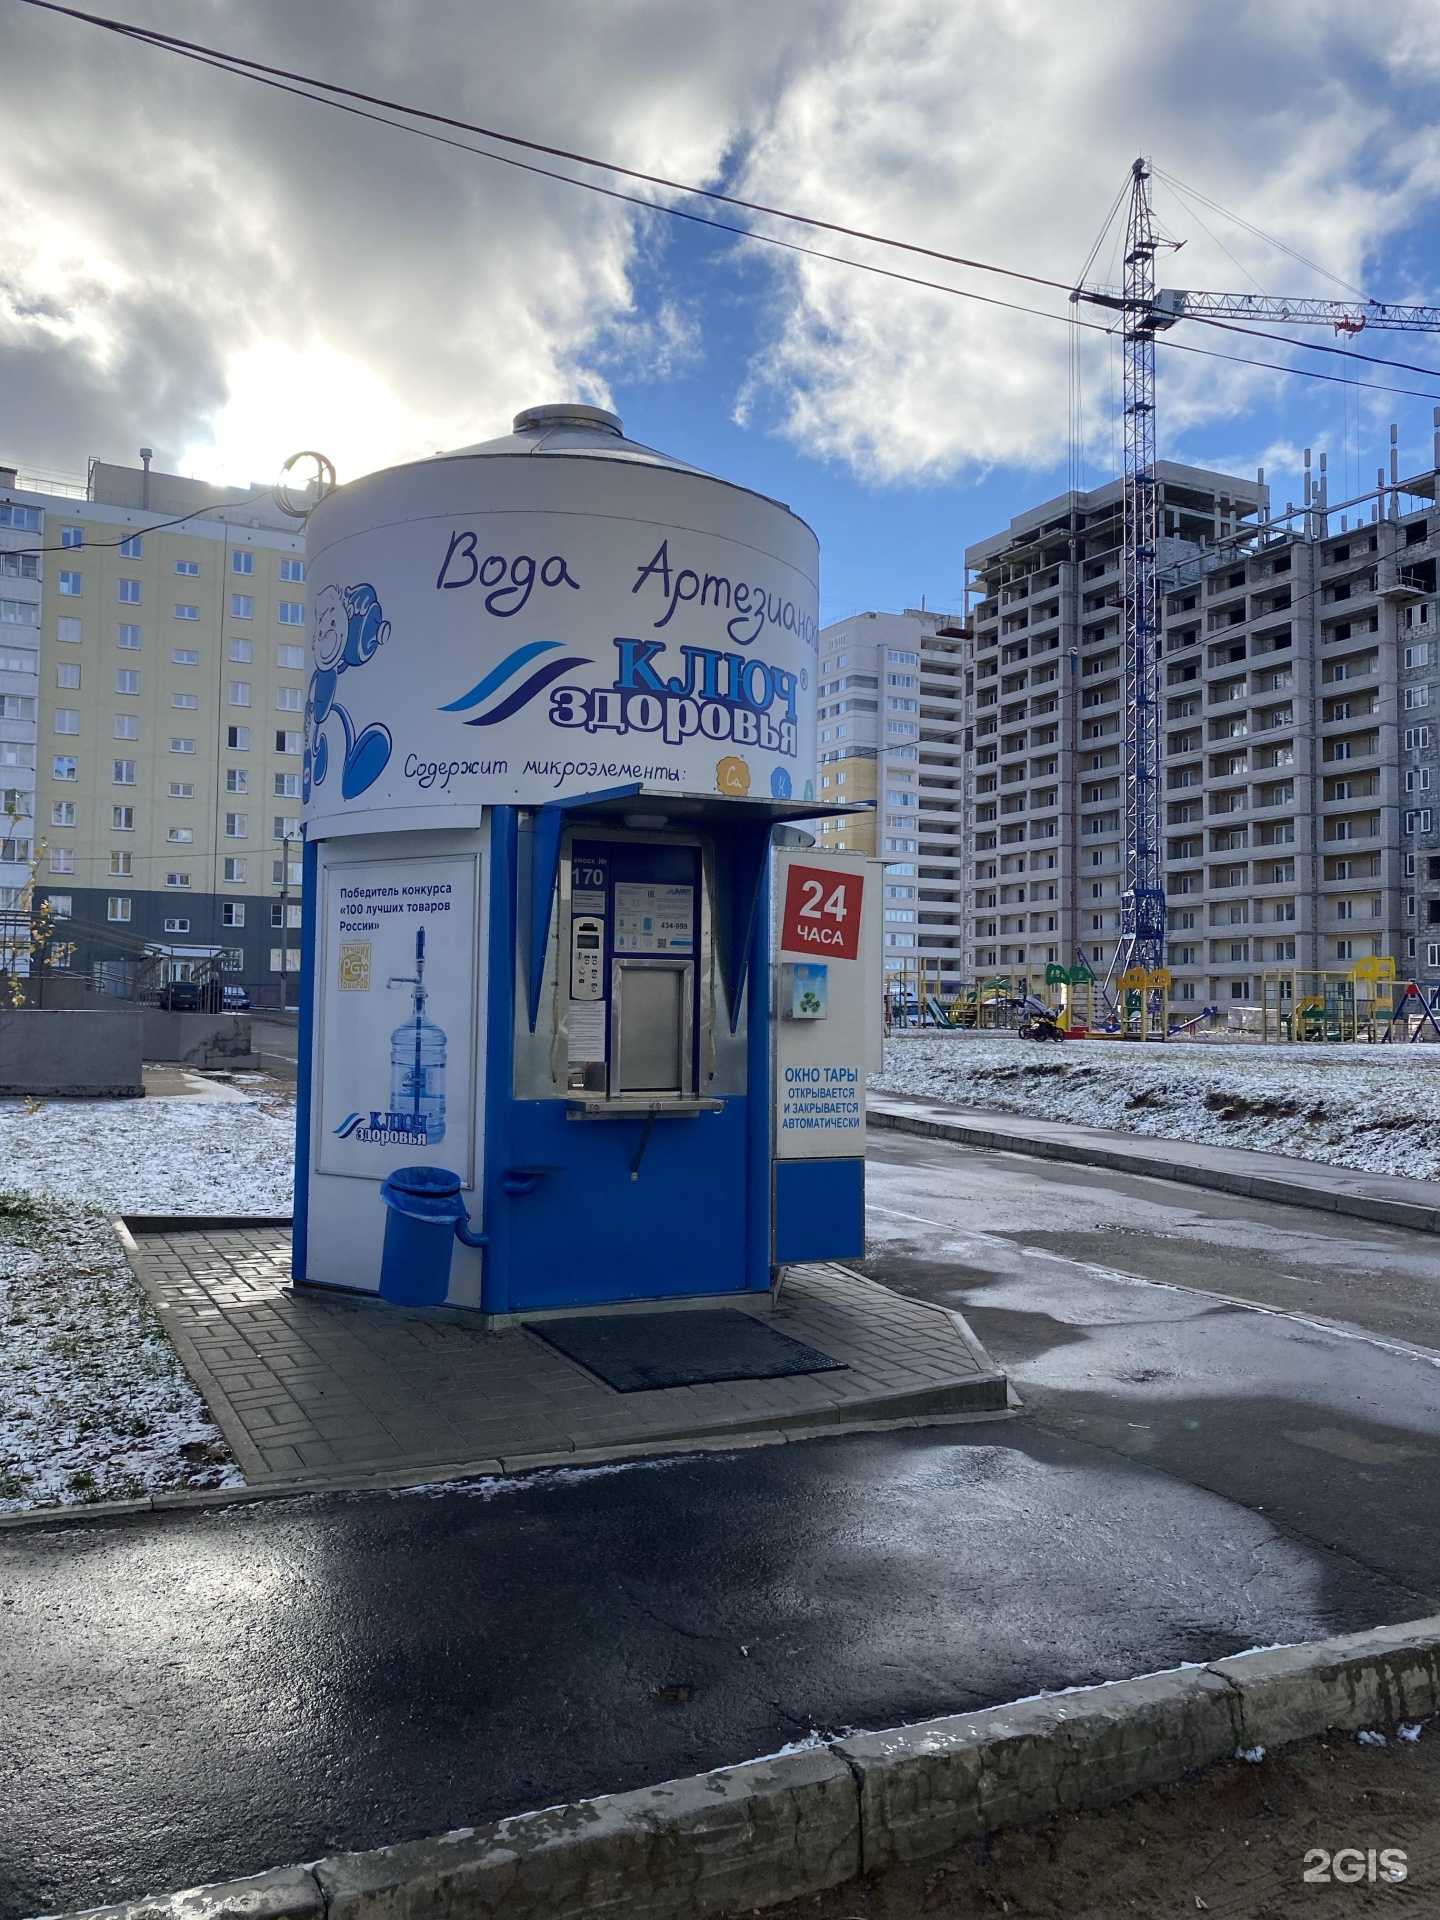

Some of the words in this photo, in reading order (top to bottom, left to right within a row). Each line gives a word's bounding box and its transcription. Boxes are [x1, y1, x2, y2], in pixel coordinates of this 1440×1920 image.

[436, 530, 580, 618] Вода
[632, 539, 819, 653] Артезианск
[404, 753, 508, 789] Содержит
[522, 760, 686, 788] микроэлементы:
[572, 867, 604, 886] 170
[340, 886, 399, 900] Победитель
[402, 884, 452, 897] конкурса
[340, 903, 364, 915] «100
[366, 903, 404, 916] лучших
[407, 901, 451, 914] товаров
[800, 880, 848, 923] 24
[339, 921, 380, 933] России»
[796, 925, 845, 946] ЧАСА
[784, 1067, 820, 1083] ОКНО
[823, 1067, 859, 1083] ТАРЫ
[787, 1087, 855, 1099] ОТКРЫВАЕТСЯ
[783, 1102, 792, 1114] И
[792, 1102, 859, 1114] ЗАКРЫВАЕТСЯ
[782, 1117, 860, 1130] АВТОМАТИЧЕСКИ
[356, 1127, 427, 1147] здоровья
